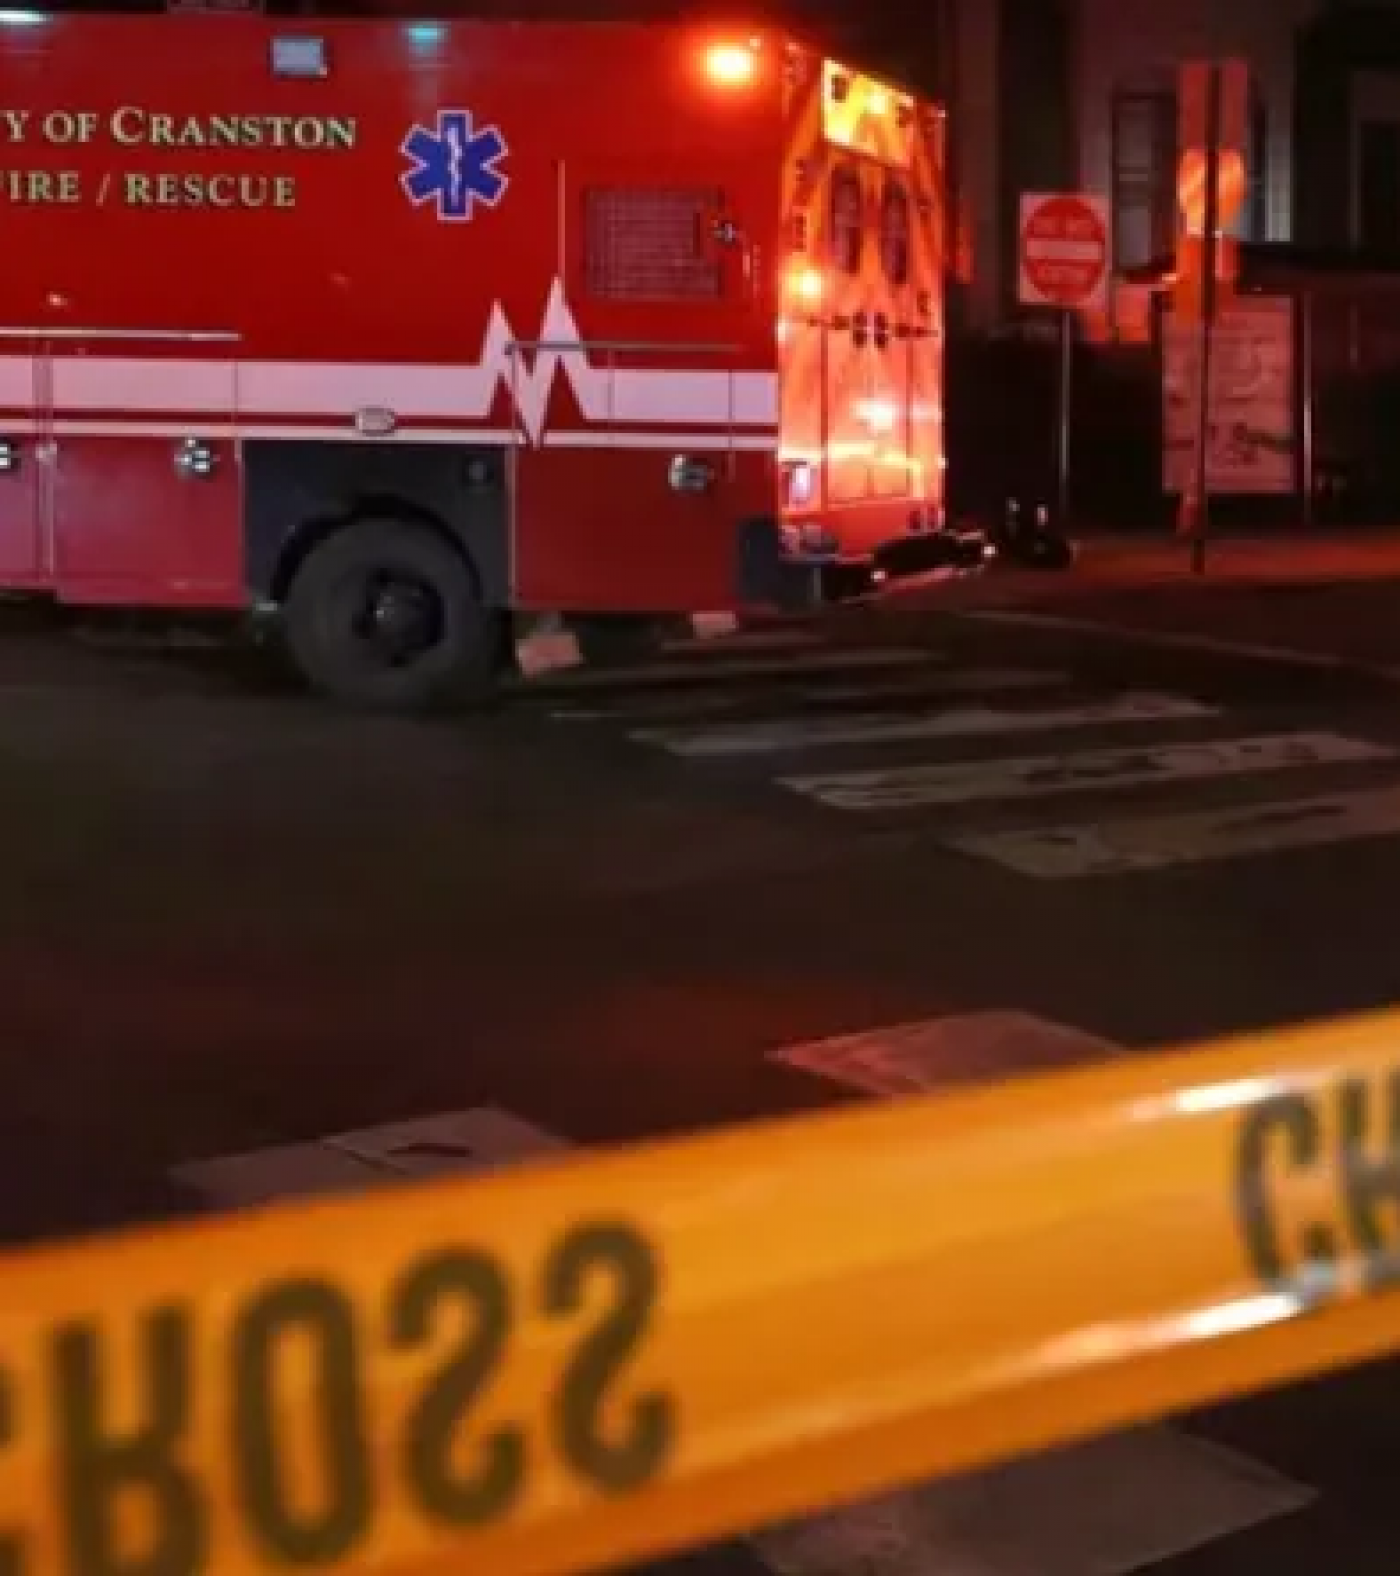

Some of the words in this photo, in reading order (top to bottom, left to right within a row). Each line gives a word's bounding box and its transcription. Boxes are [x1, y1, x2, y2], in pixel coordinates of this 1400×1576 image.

[0, 110, 29, 143] Y
[43, 109, 98, 143] OF
[110, 105, 357, 148] CRANSTON
[0, 169, 82, 203] IRE
[122, 172, 297, 207] RESCUE
